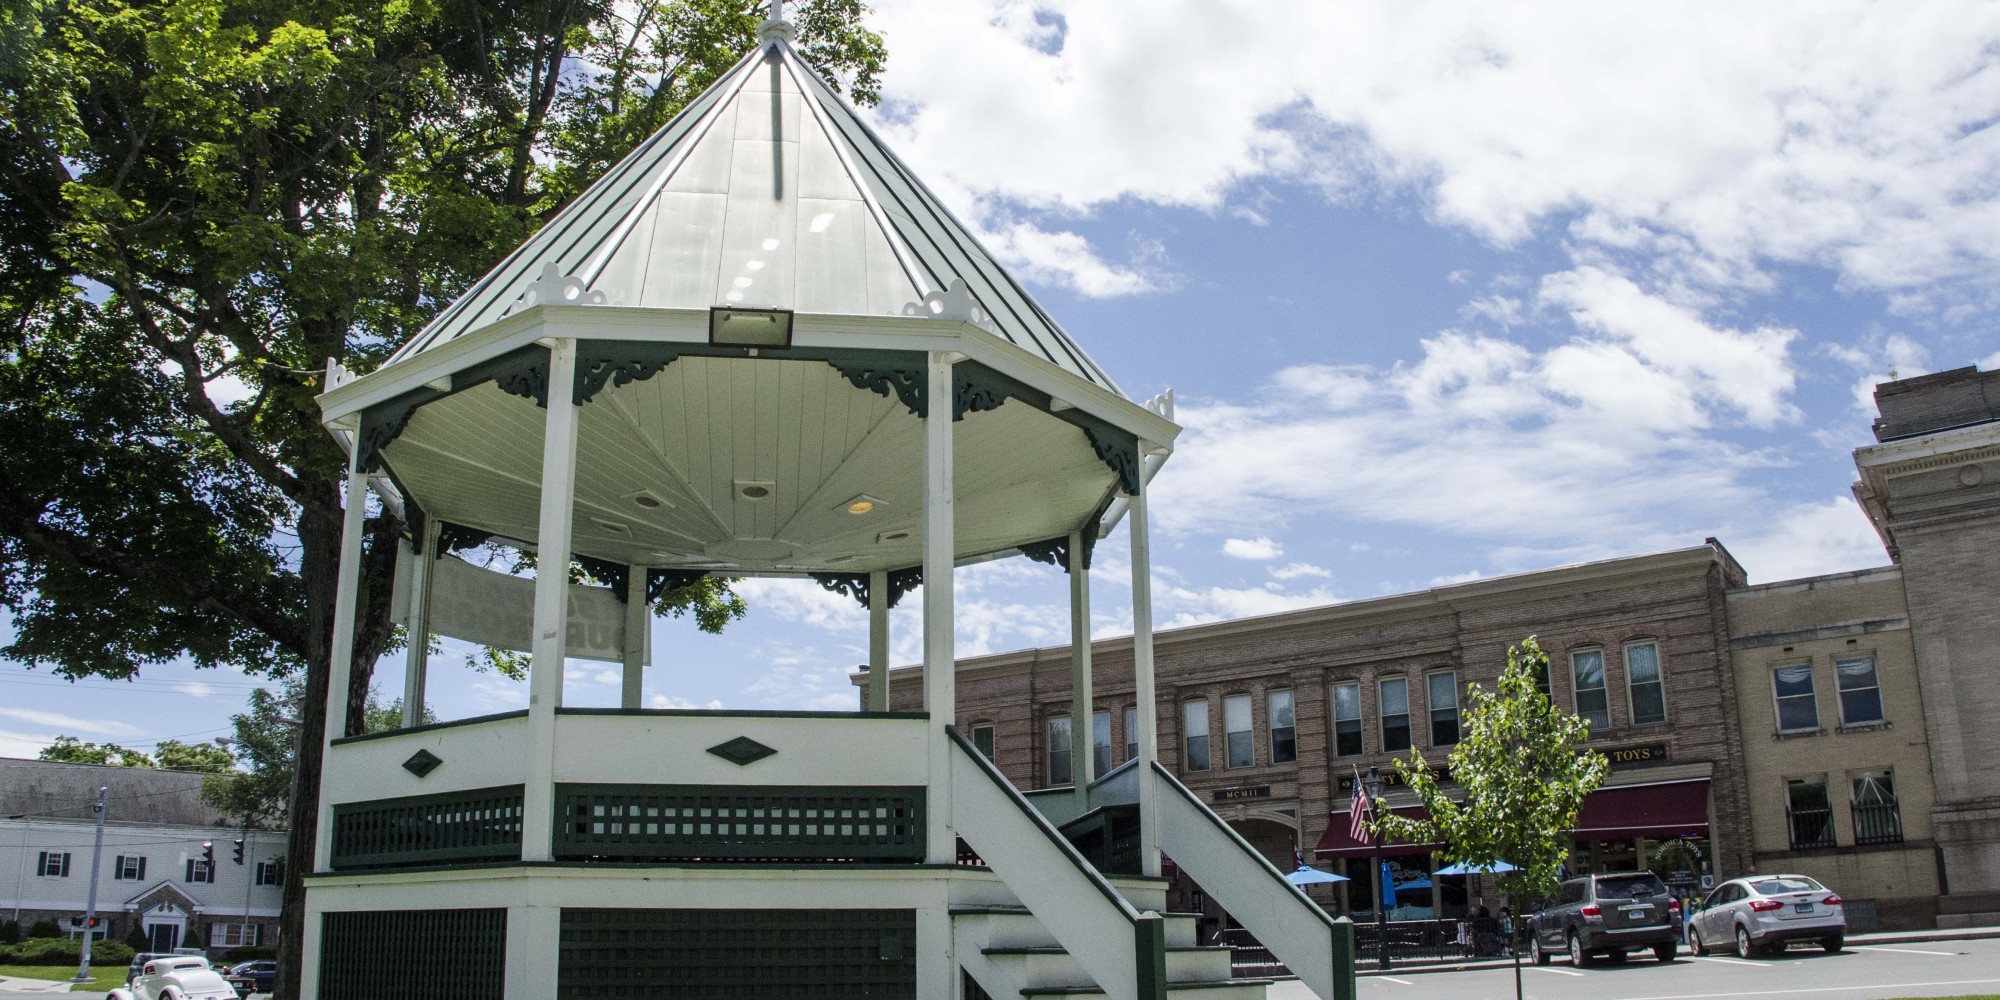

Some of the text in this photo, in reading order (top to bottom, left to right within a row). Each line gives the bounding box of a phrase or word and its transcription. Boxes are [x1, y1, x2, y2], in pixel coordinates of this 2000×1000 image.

[1614, 748, 1650, 762] TOYS
[1226, 789, 1257, 799] MCMII
[1655, 838, 1702, 860] NORDICA TOYS
